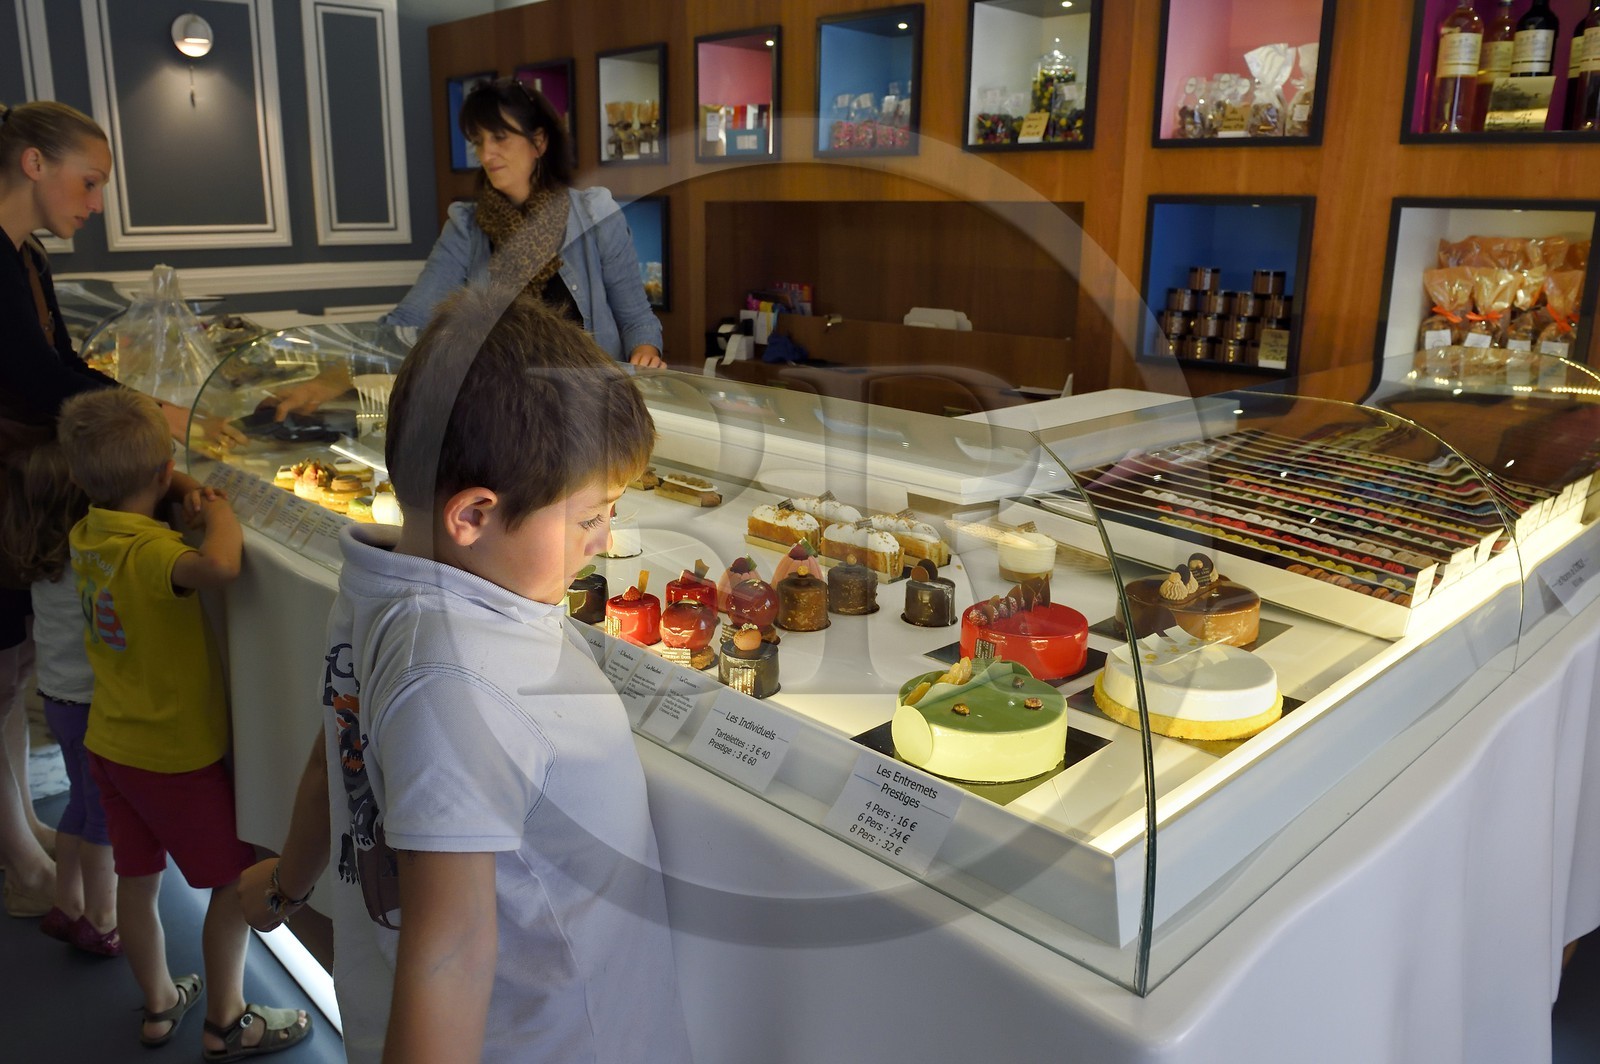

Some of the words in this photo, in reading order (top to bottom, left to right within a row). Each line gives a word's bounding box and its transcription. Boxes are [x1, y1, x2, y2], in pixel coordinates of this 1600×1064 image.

[726, 712, 738, 724] Les
[739, 717, 776, 740] Individuels
[708, 738, 732, 755] Prestige
[748, 757, 757, 766] 60
[715, 728, 746, 748] Tartelettes
[762, 750, 770, 759] 40
[876, 764, 891, 779] Les
[893, 771, 938, 799] Entremets
[881, 783, 920, 808] Prestiges
[858, 812, 864, 822] 6
[864, 816, 883, 831] Pers
[889, 829, 901, 840] 24
[902, 834, 911, 844] €
[865, 801, 872, 810] 4
[872, 804, 890, 819] Pers
[897, 817, 908, 828] 16
[910, 822, 918, 831] €
[850, 824, 856, 833] 8
[856, 827, 876, 843] Pers
[881, 840, 893, 851] 32
[894, 846, 903, 856] €
